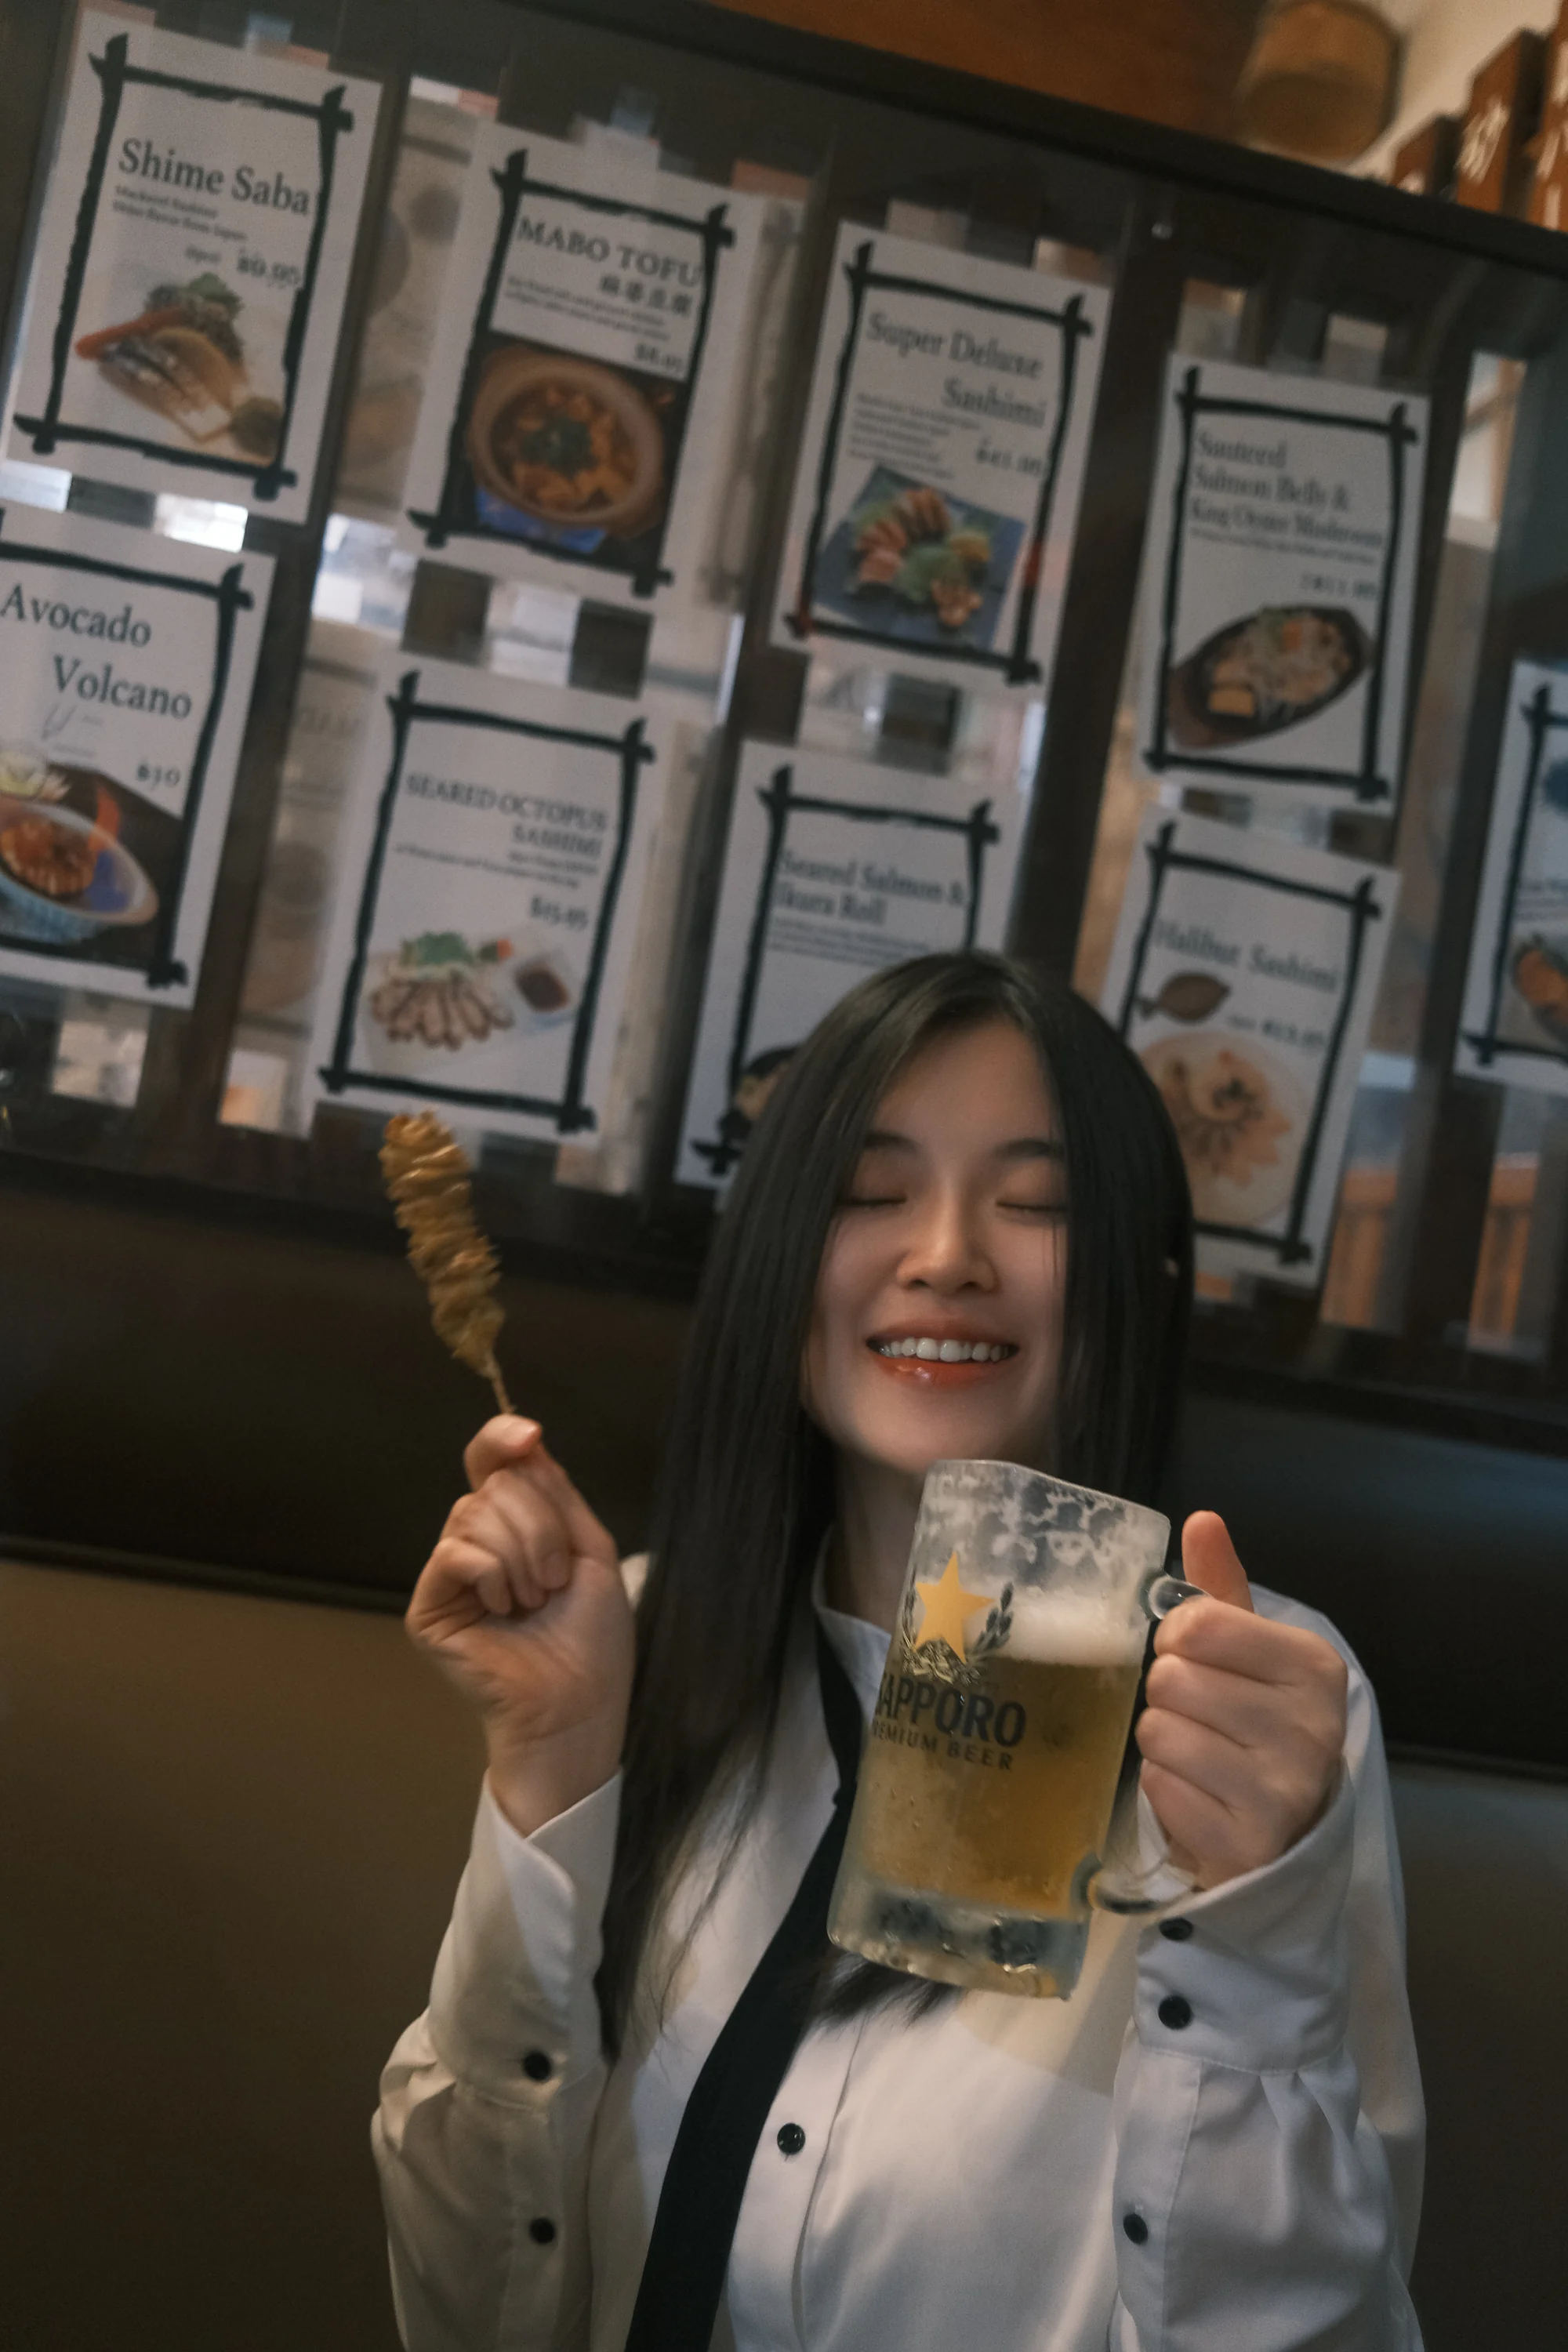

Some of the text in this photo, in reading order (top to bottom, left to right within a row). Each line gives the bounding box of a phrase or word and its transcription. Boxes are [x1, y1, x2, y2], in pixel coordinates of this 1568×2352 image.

[118, 137, 224, 195] Shime
[231, 163, 310, 216] Saba
[517, 216, 702, 288] MABO TOFU
[0, 583, 152, 648] Avocado
[53, 654, 192, 720] Volcano
[497, 792, 608, 832] OCTOPUS
[947, 1739, 1014, 1771] BEER
